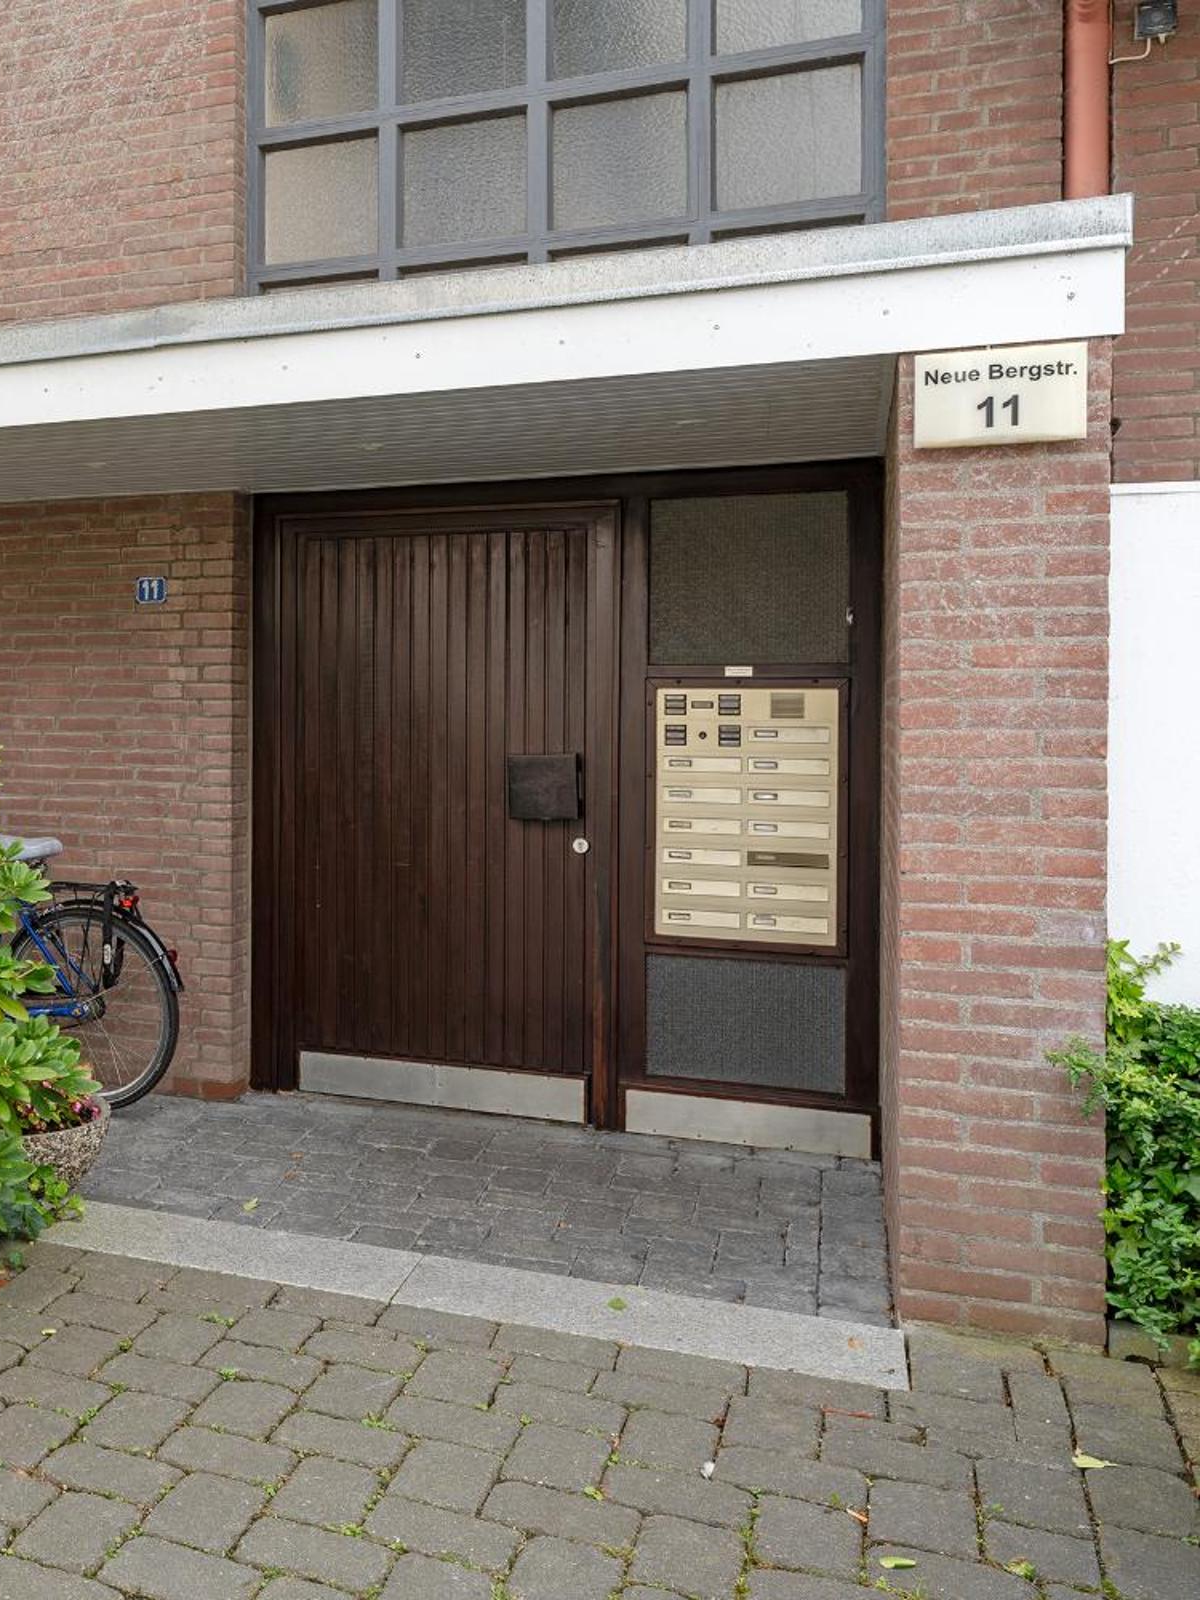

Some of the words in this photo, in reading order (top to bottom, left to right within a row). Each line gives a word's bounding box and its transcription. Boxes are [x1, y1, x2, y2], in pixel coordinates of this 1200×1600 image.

[924, 369, 980, 386] Neue
[989, 360, 1078, 381] Bergstr.
[977, 394, 1019, 428] 11
[142, 580, 159, 600] 11
